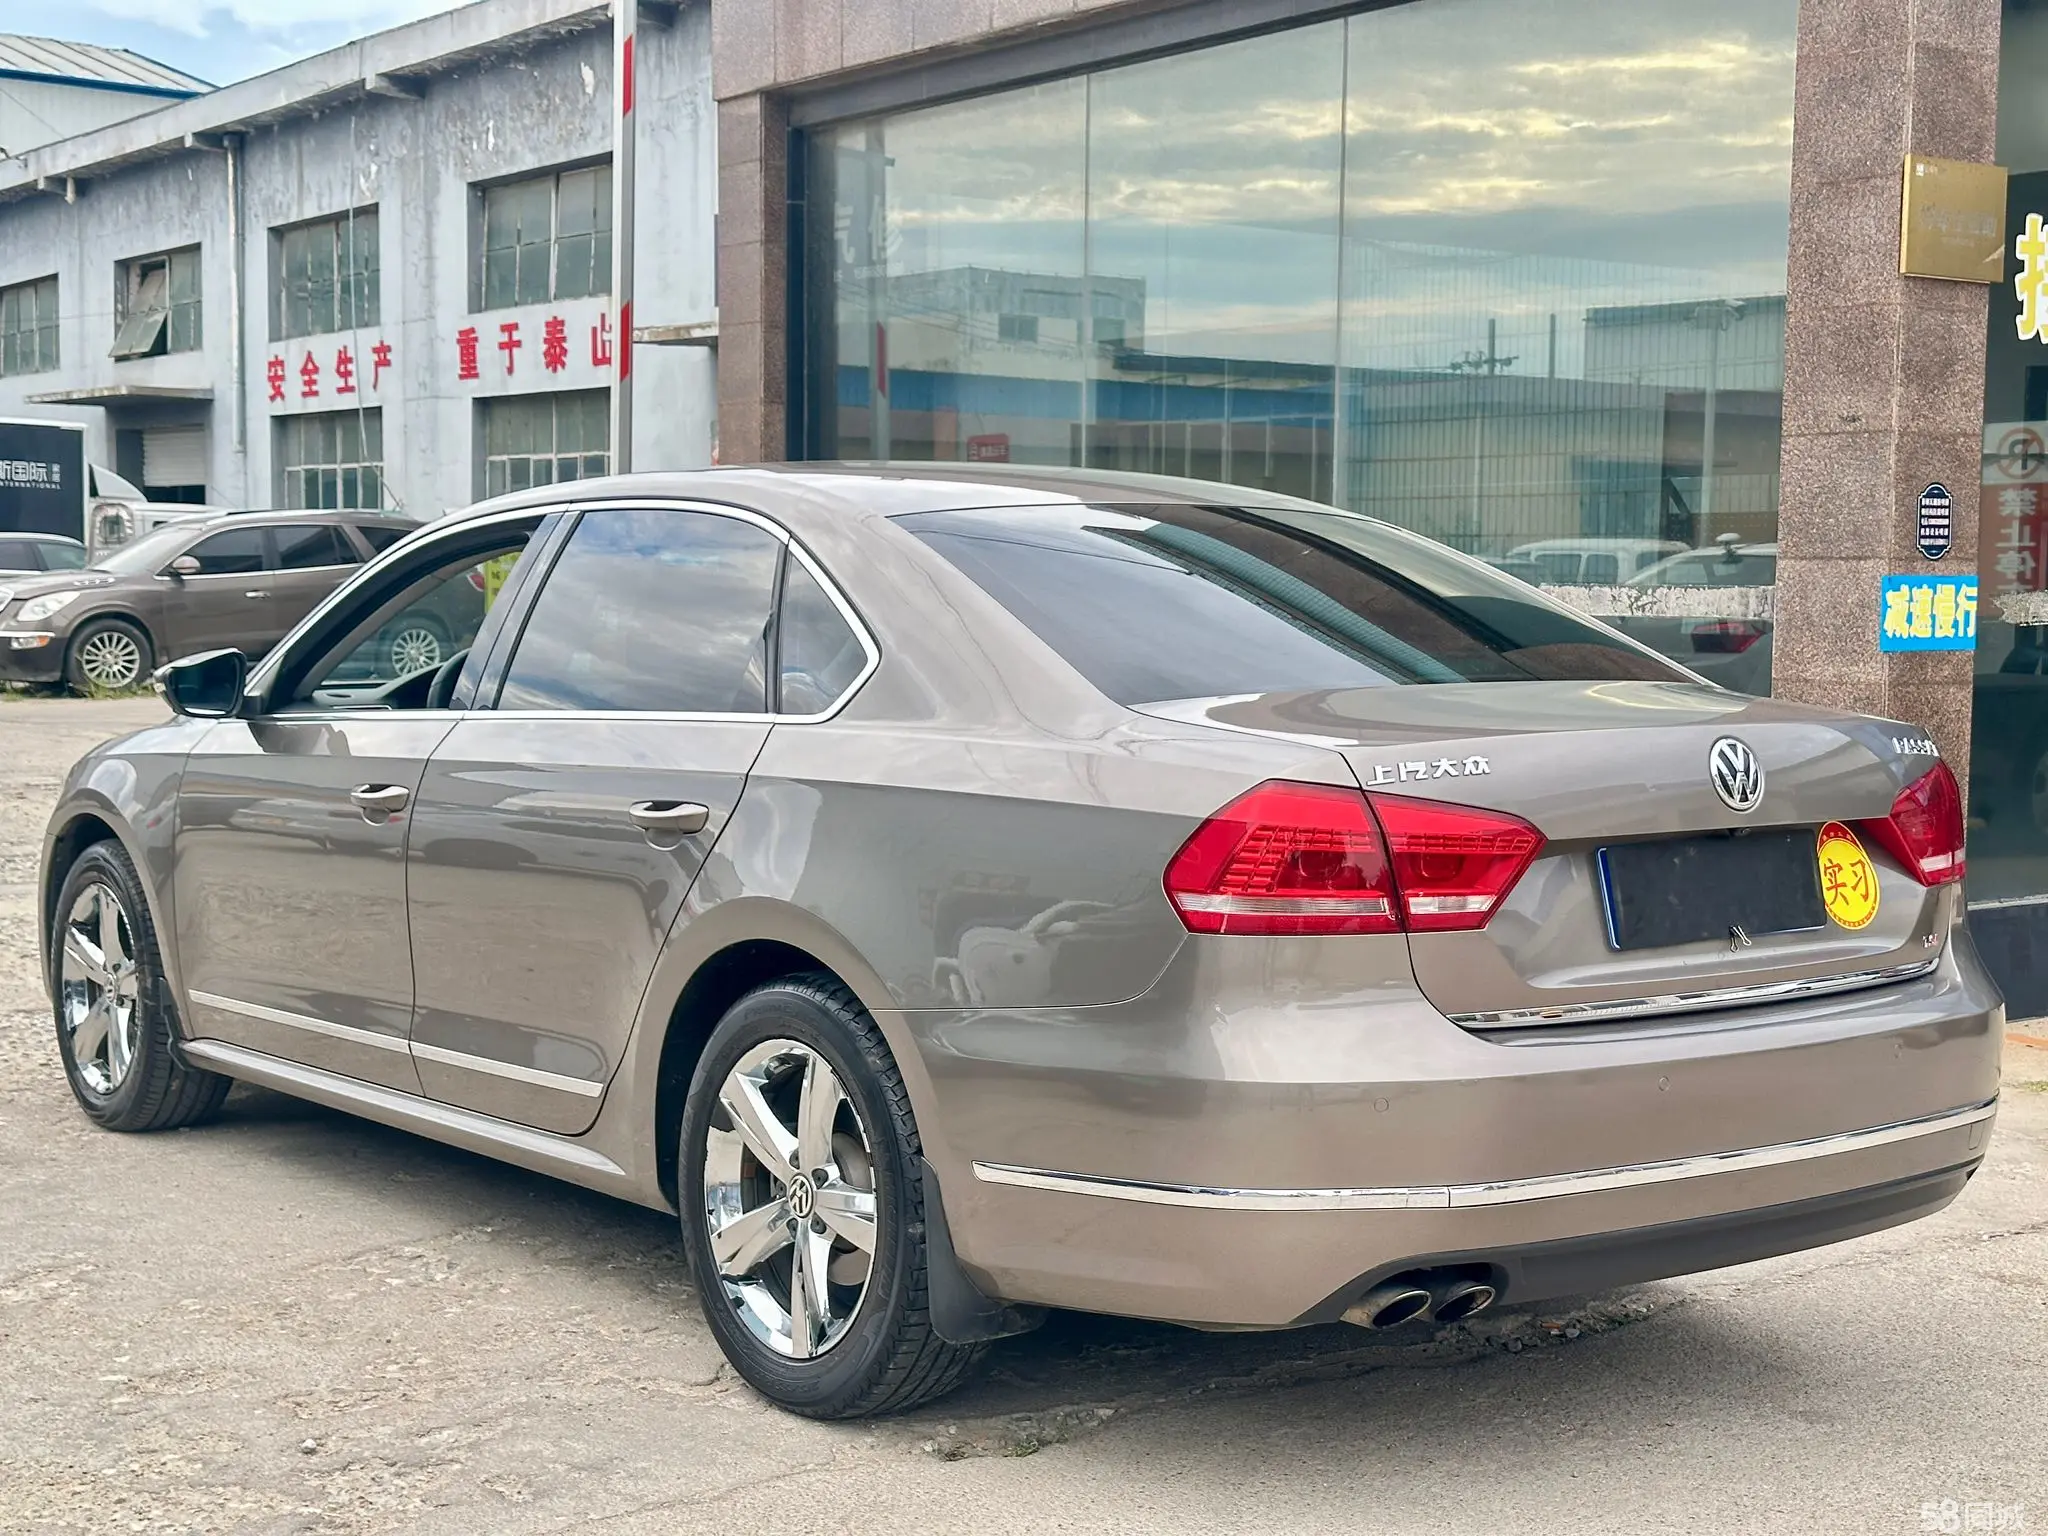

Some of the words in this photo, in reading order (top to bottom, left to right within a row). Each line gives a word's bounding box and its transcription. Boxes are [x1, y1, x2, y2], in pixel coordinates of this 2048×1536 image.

[267, 340, 392, 402] 安全生产
[456, 313, 612, 380] 重于泰山
[1884, 583, 1978, 639] 减速慢行
[1366, 755, 1491, 786] 上汽大众
[1823, 857, 1870, 906] 实习
